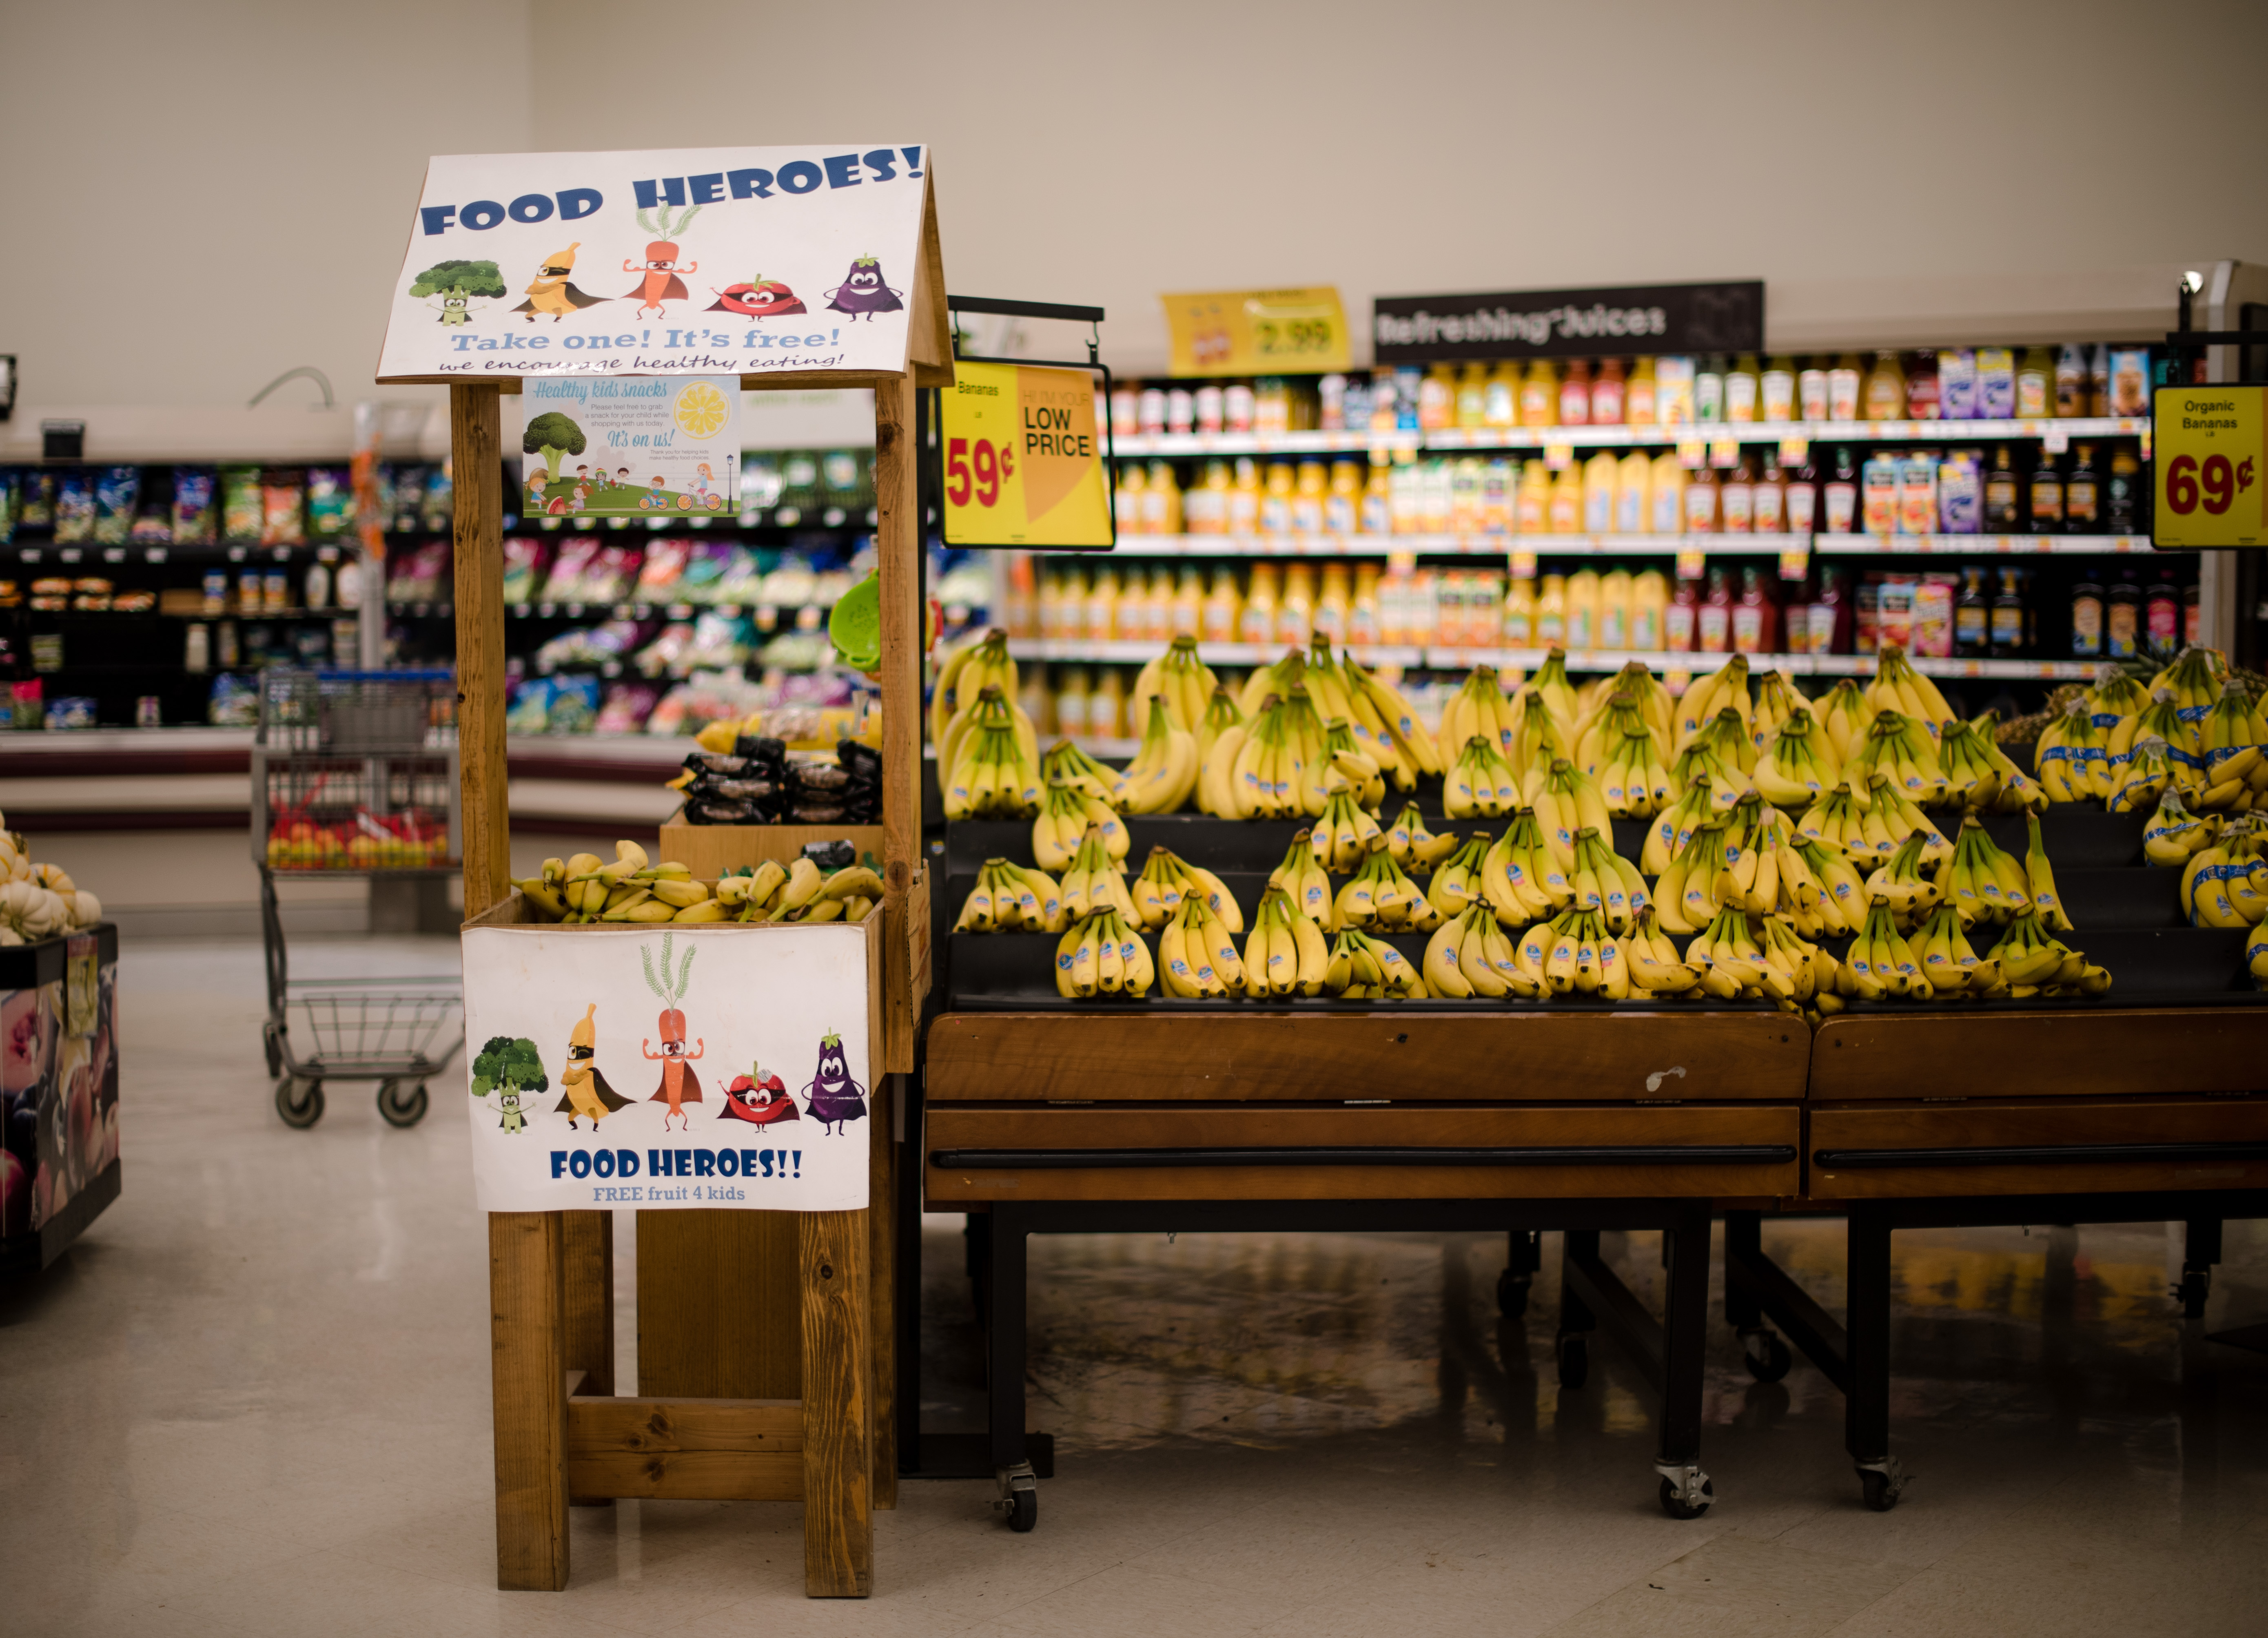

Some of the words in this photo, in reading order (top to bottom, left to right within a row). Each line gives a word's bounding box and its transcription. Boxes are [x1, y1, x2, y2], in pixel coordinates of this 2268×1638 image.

[420, 187, 604, 236] FOOD
[632, 145, 924, 209] HEROES!
[1377, 306, 1550, 345] Refreshing
[1555, 303, 1667, 338] Juices
[450, 332, 550, 351] Take
[563, 330, 651, 350] one!
[664, 329, 730, 348] It's
[743, 328, 840, 348] free!
[439, 360, 474, 371] we
[484, 358, 623, 373] encourage
[634, 355, 738, 370] healthy
[749, 354, 845, 368] eating!
[533, 380, 588, 405] Healthy
[592, 380, 619, 398] kids
[621, 380, 667, 398] snacks
[958, 381, 999, 396] Bananas
[1024, 407, 1072, 431] LOW
[2184, 400, 2235, 415] Organic
[2183, 417, 2238, 429] Bananas
[607, 429, 629, 447] It's
[632, 434, 650, 447] on
[653, 428, 675, 447] us!
[1026, 433, 1091, 457] PRICE
[550, 1149, 641, 1179] FOOD
[647, 1148, 803, 1178] HEROES!!
[593, 1186, 643, 1202] FREE
[648, 1185, 688, 1201] fruit
[692, 1186, 703, 1200] 4
[707, 1185, 745, 1201] kids
